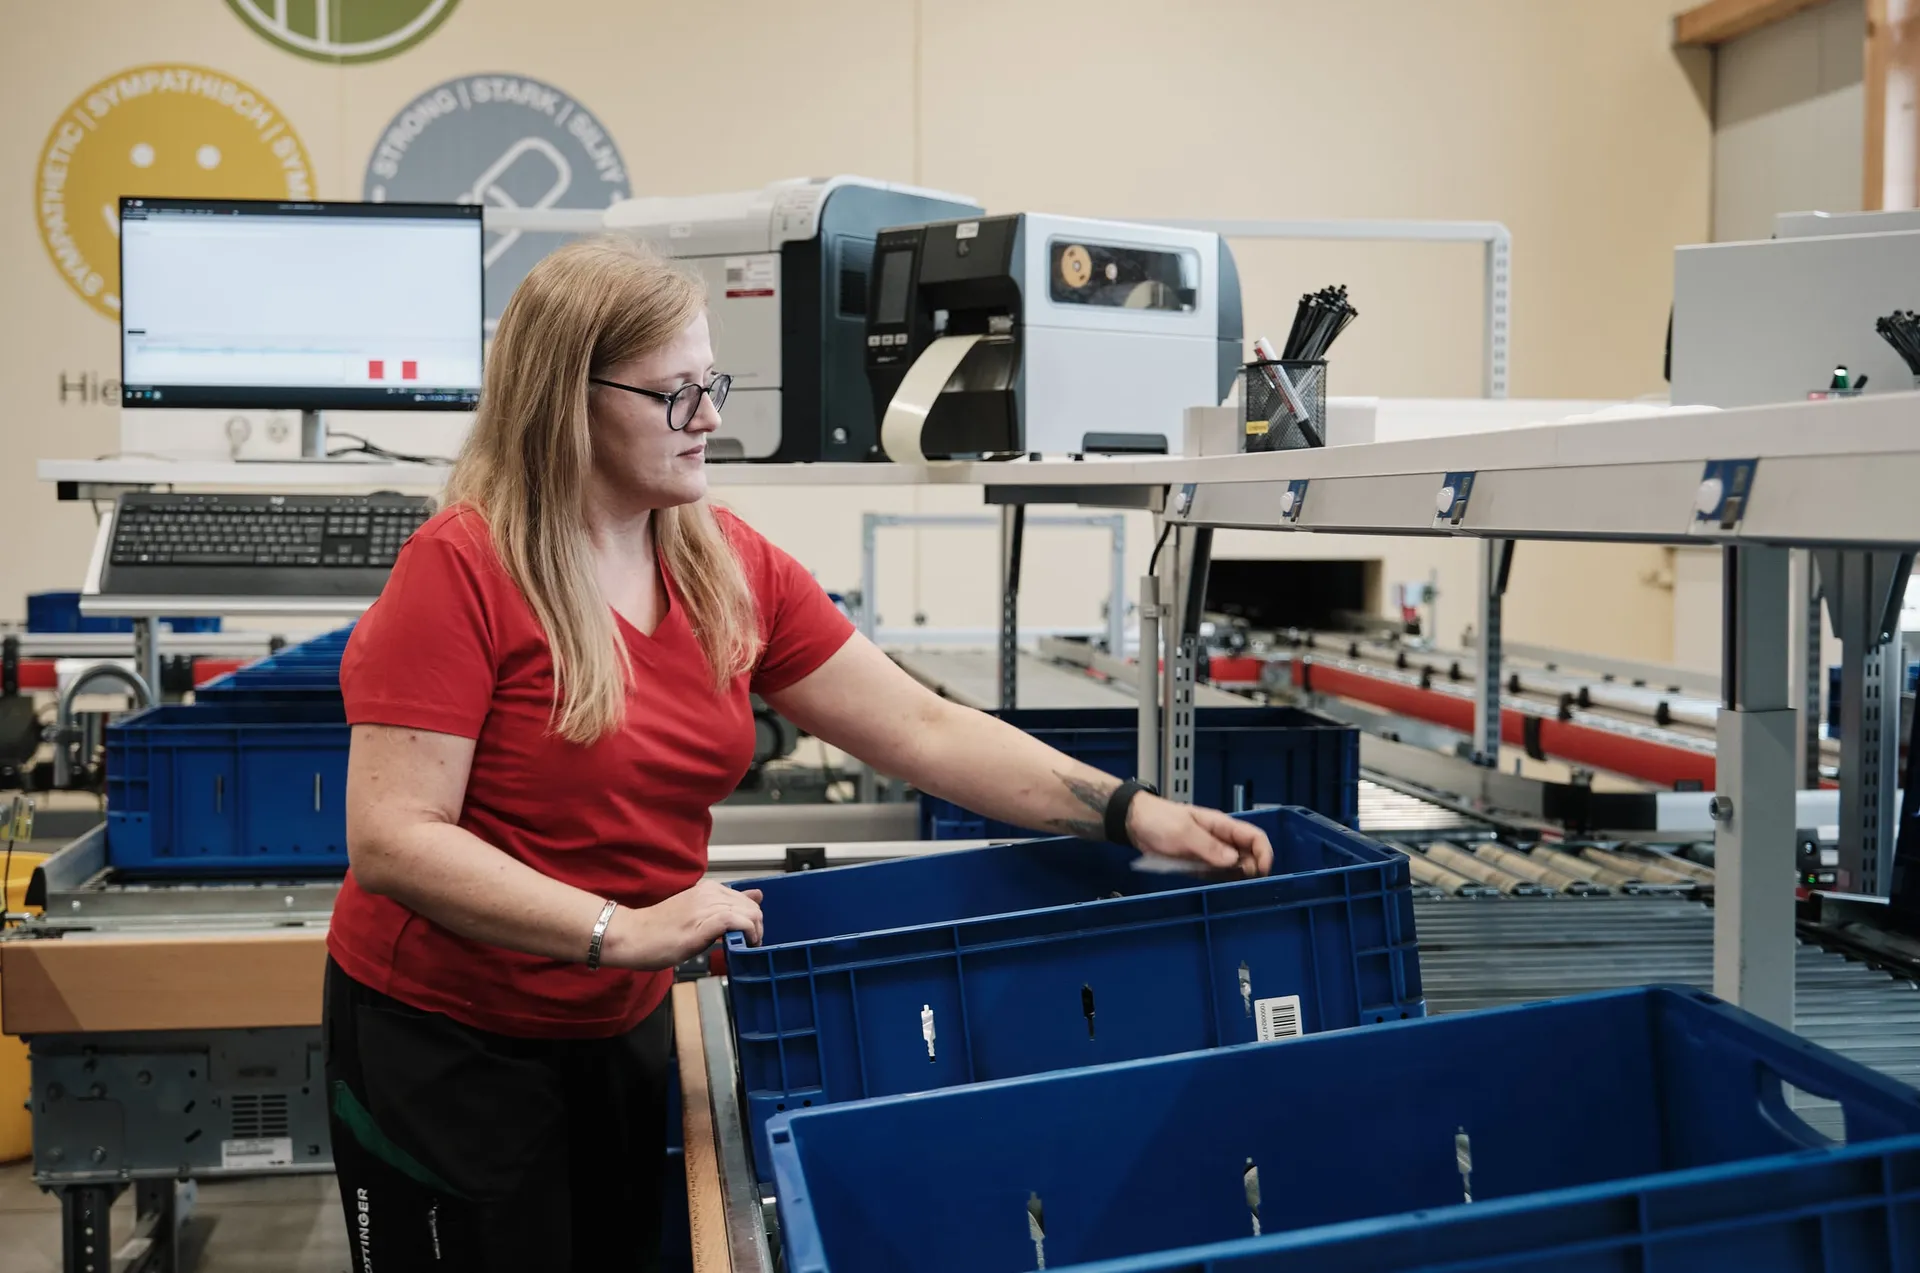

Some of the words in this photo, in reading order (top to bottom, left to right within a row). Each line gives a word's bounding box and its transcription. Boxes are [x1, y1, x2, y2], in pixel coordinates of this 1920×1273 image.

[42, 121, 105, 297] SYMPATHETIC
[84, 68, 274, 130] SYMPATHISCH
[372, 88, 459, 180] STRONG
[471, 77, 560, 117] STARK
